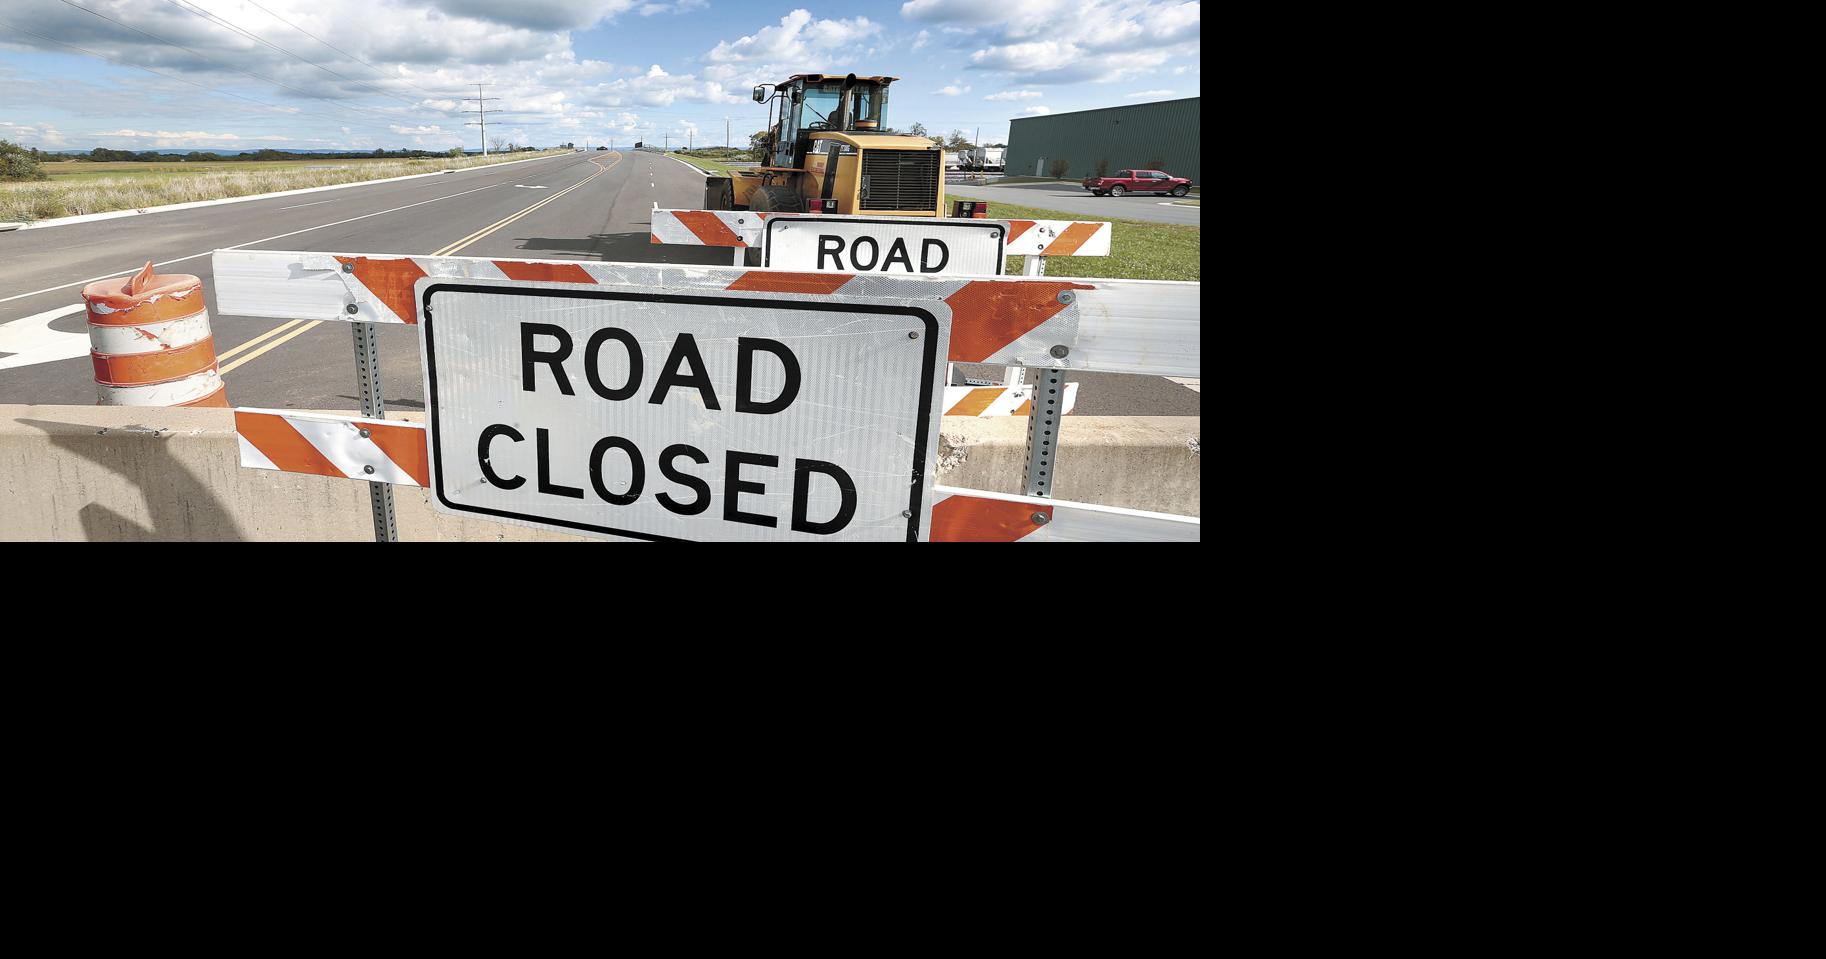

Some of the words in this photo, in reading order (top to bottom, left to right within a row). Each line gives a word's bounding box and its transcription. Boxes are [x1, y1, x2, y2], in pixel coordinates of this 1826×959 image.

[817, 234, 950, 273] ROAD
[520, 321, 802, 415] ROAD
[477, 423, 858, 536] CLOSED
